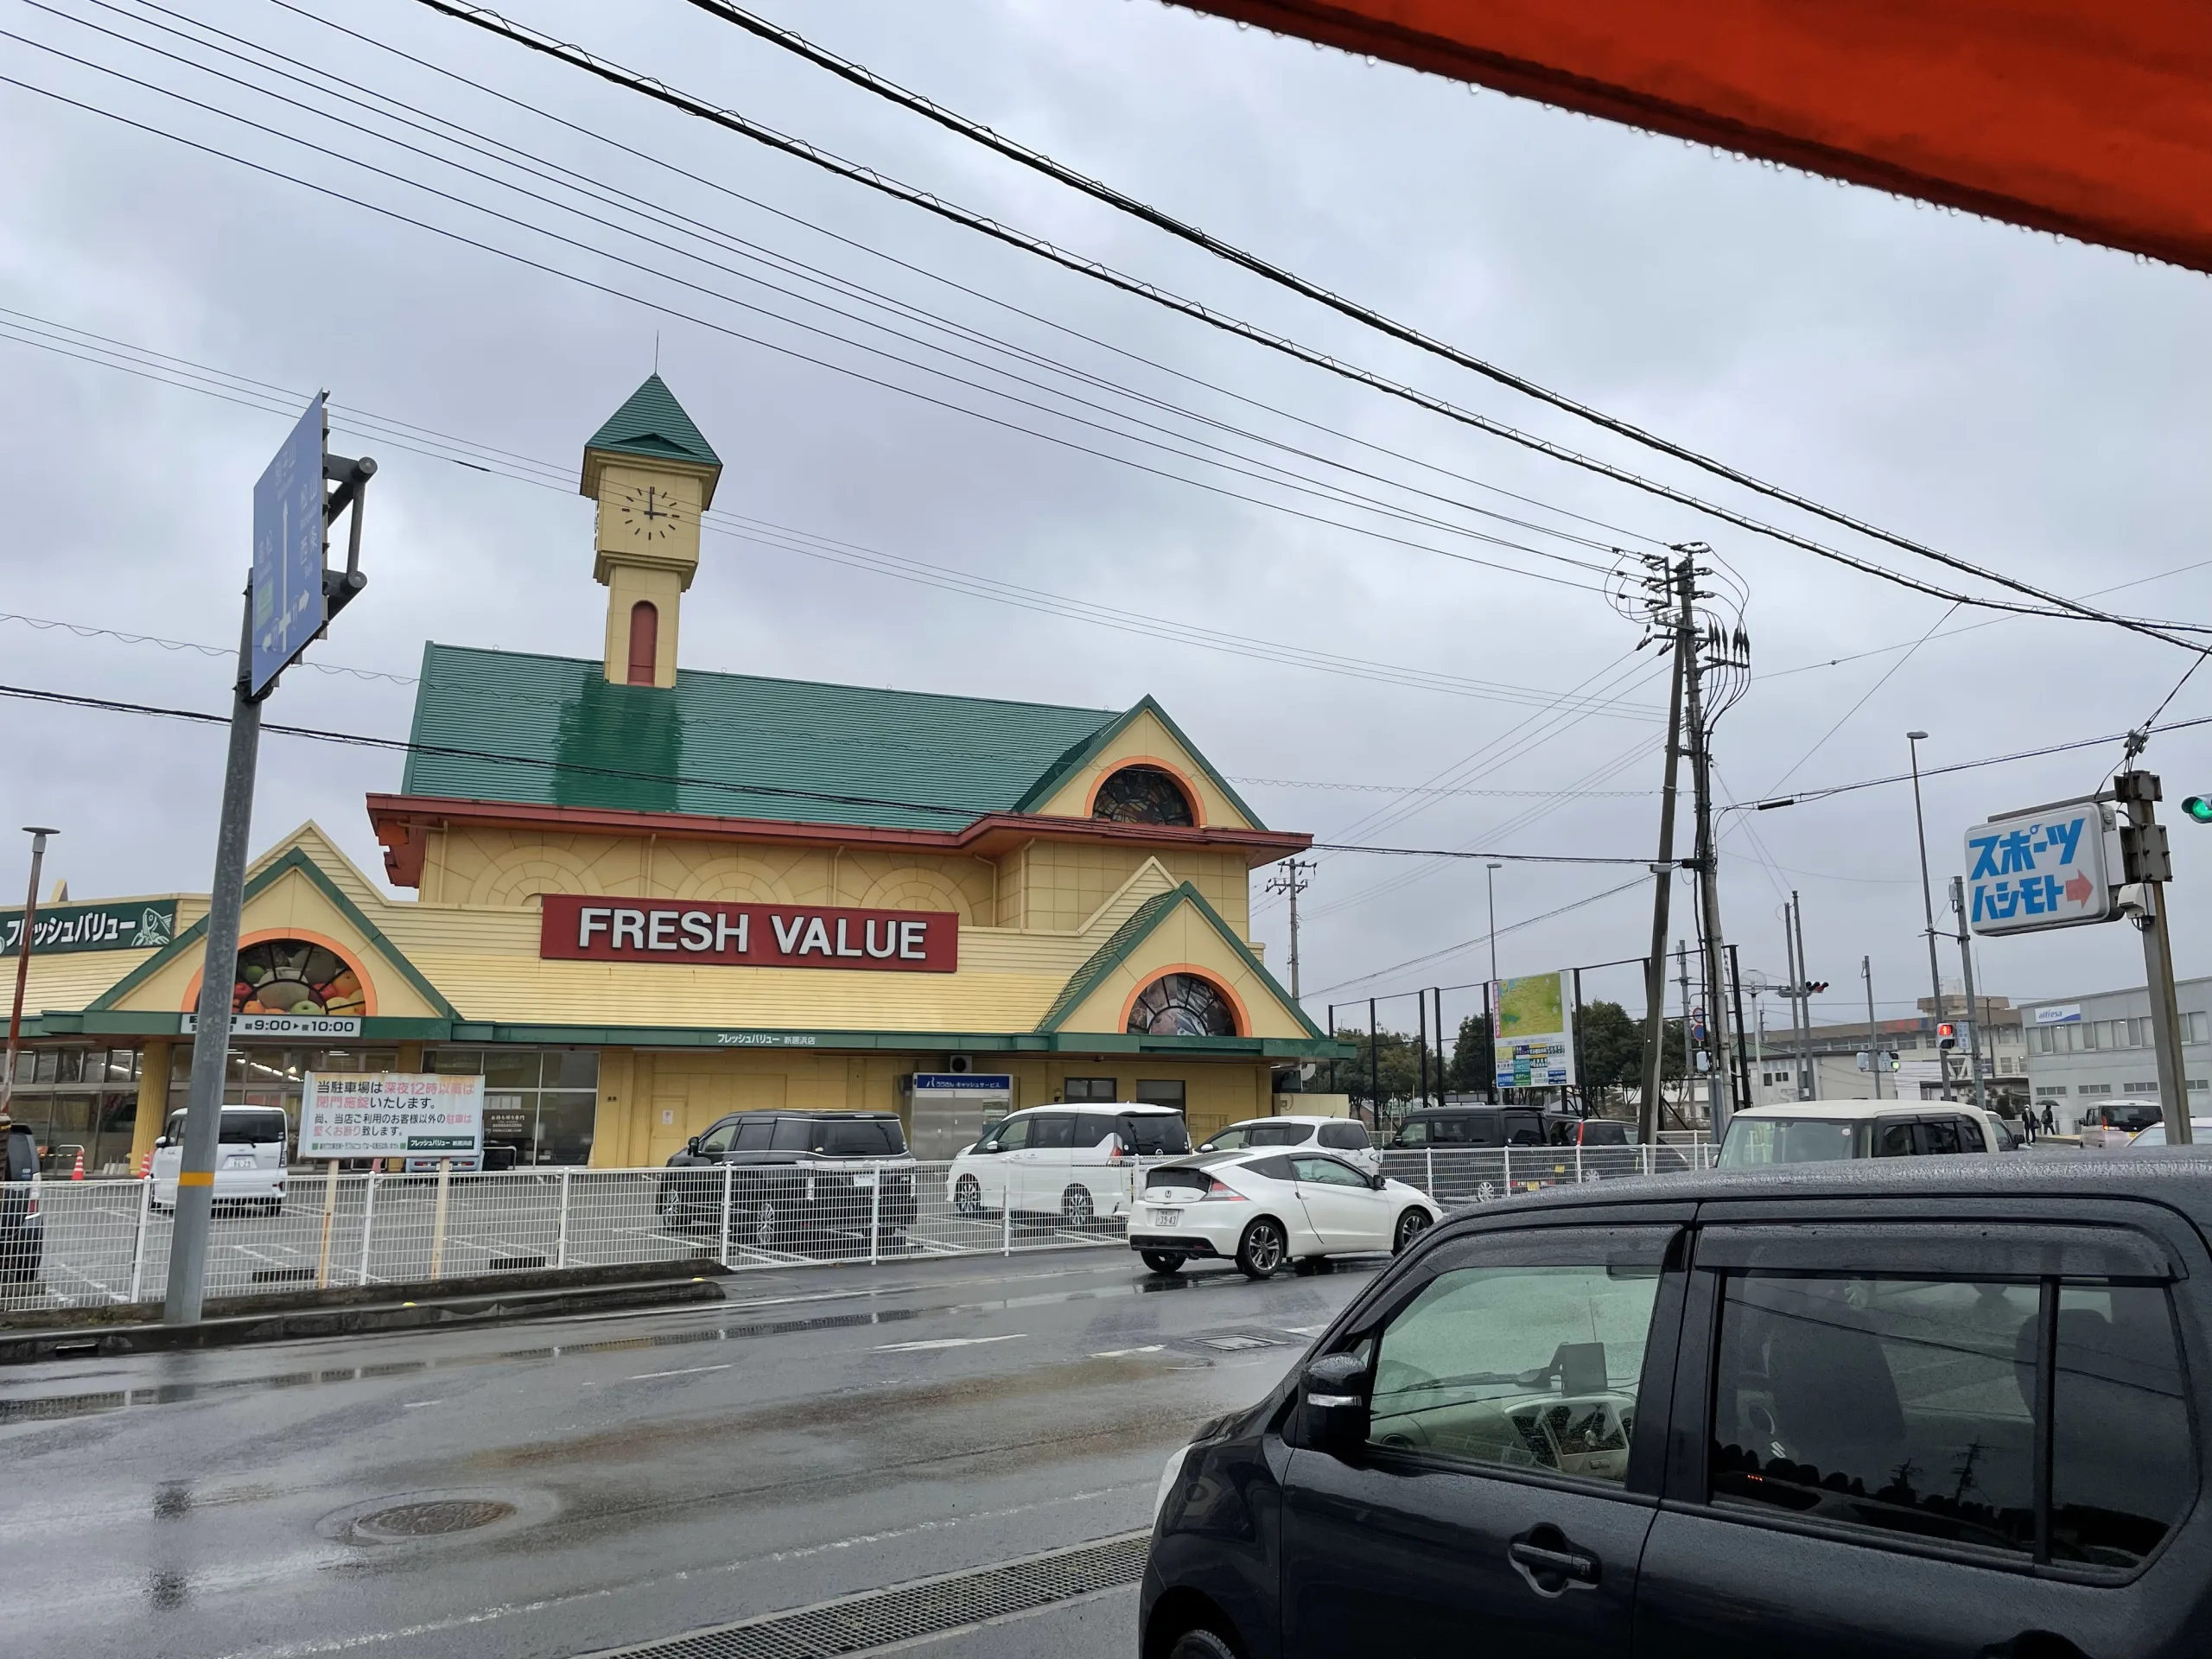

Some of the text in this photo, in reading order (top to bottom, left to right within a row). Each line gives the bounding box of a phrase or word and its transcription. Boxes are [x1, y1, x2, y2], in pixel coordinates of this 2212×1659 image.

[300, 471, 318, 513] 松山
[300, 524, 318, 566] 西条
[1969, 818, 2086, 880] スポーツ
[1972, 874, 2064, 922] ハシモト
[578, 907, 927, 959] FRESH VALUE
[2039, 1009, 2063, 1019] alfresa
[717, 1033, 816, 1045] フレッシュバリュー 新居浜店
